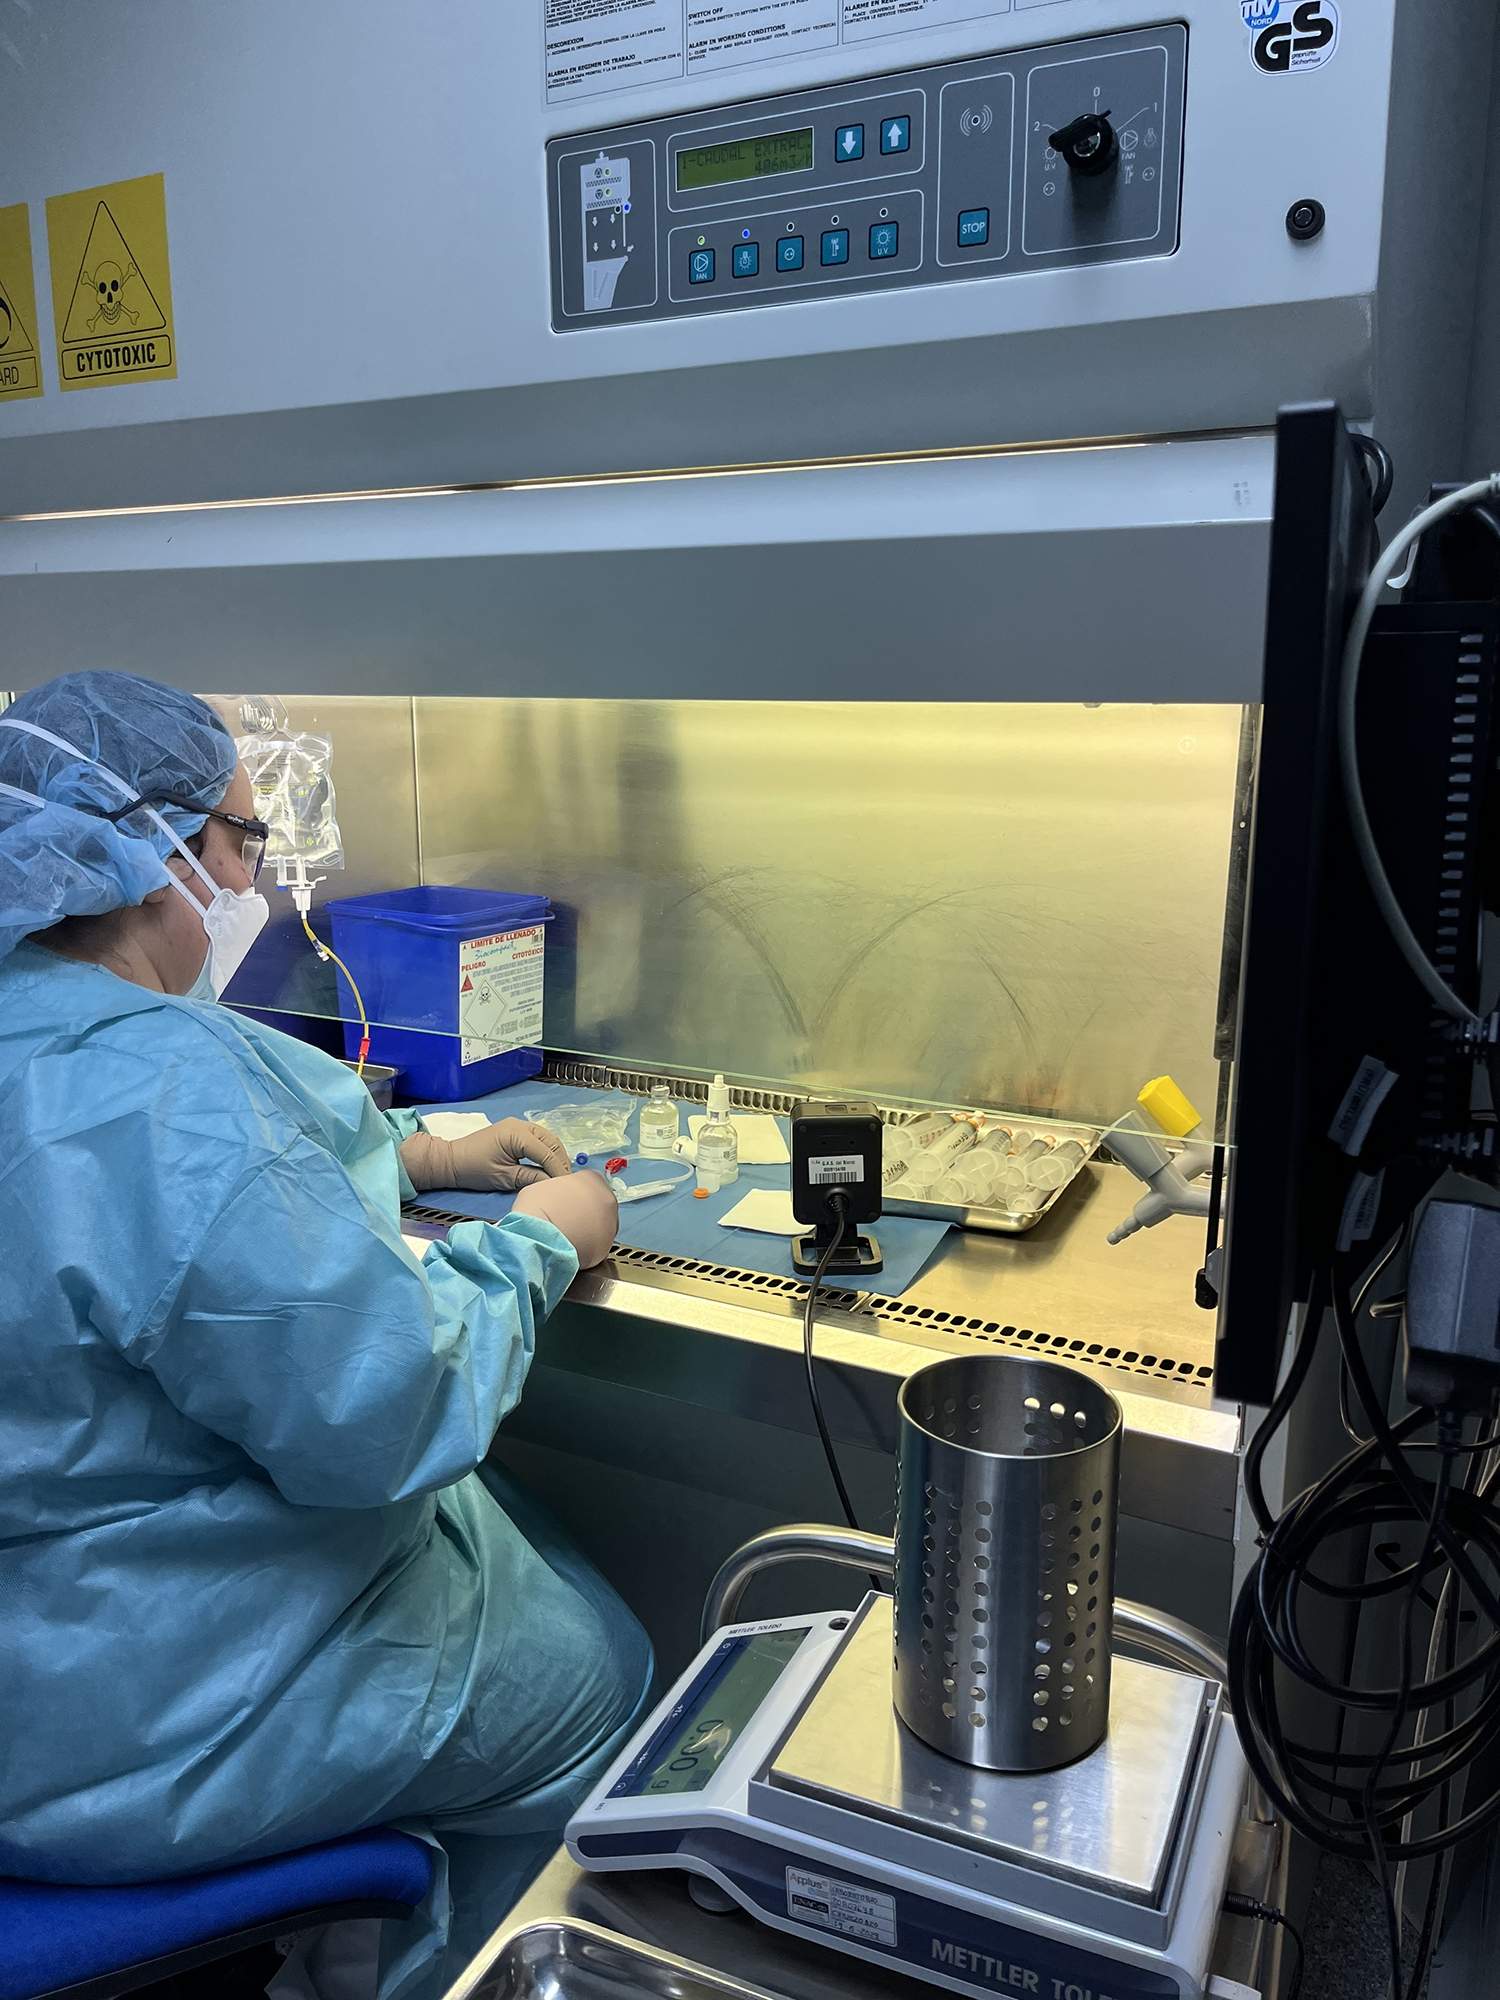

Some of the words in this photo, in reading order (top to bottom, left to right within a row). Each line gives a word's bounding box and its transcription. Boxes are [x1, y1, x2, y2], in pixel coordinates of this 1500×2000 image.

[688, 10, 711, 20] SWITCH
[712, 7, 724, 15] OFF
[844, 2, 870, 12] ALARME
[1251, 18, 1273, 26] NORD
[689, 41, 708, 49] ALARM
[718, 32, 746, 43] WORKING
[747, 24, 786, 37] CONDITIONS
[1254, 1, 1334, 71] GS
[548, 69, 569, 78] ALARMA
[611, 53, 636, 64] TRABAJO
[1093, 87, 1100, 97] 0
[1153, 102, 1158, 112] 1
[1034, 121, 1041, 131] 2
[962, 221, 986, 235] STOP
[695, 272, 708, 280] FAN
[76, 342, 156, 373] CYTOTOXIC
[470, 937, 494, 949] LIMITE
[495, 934, 505, 944] DE
[506, 929, 536, 942] LLENADO
[461, 960, 487, 972] PELIGRO
[931, 1938, 1040, 1994] METTLER
